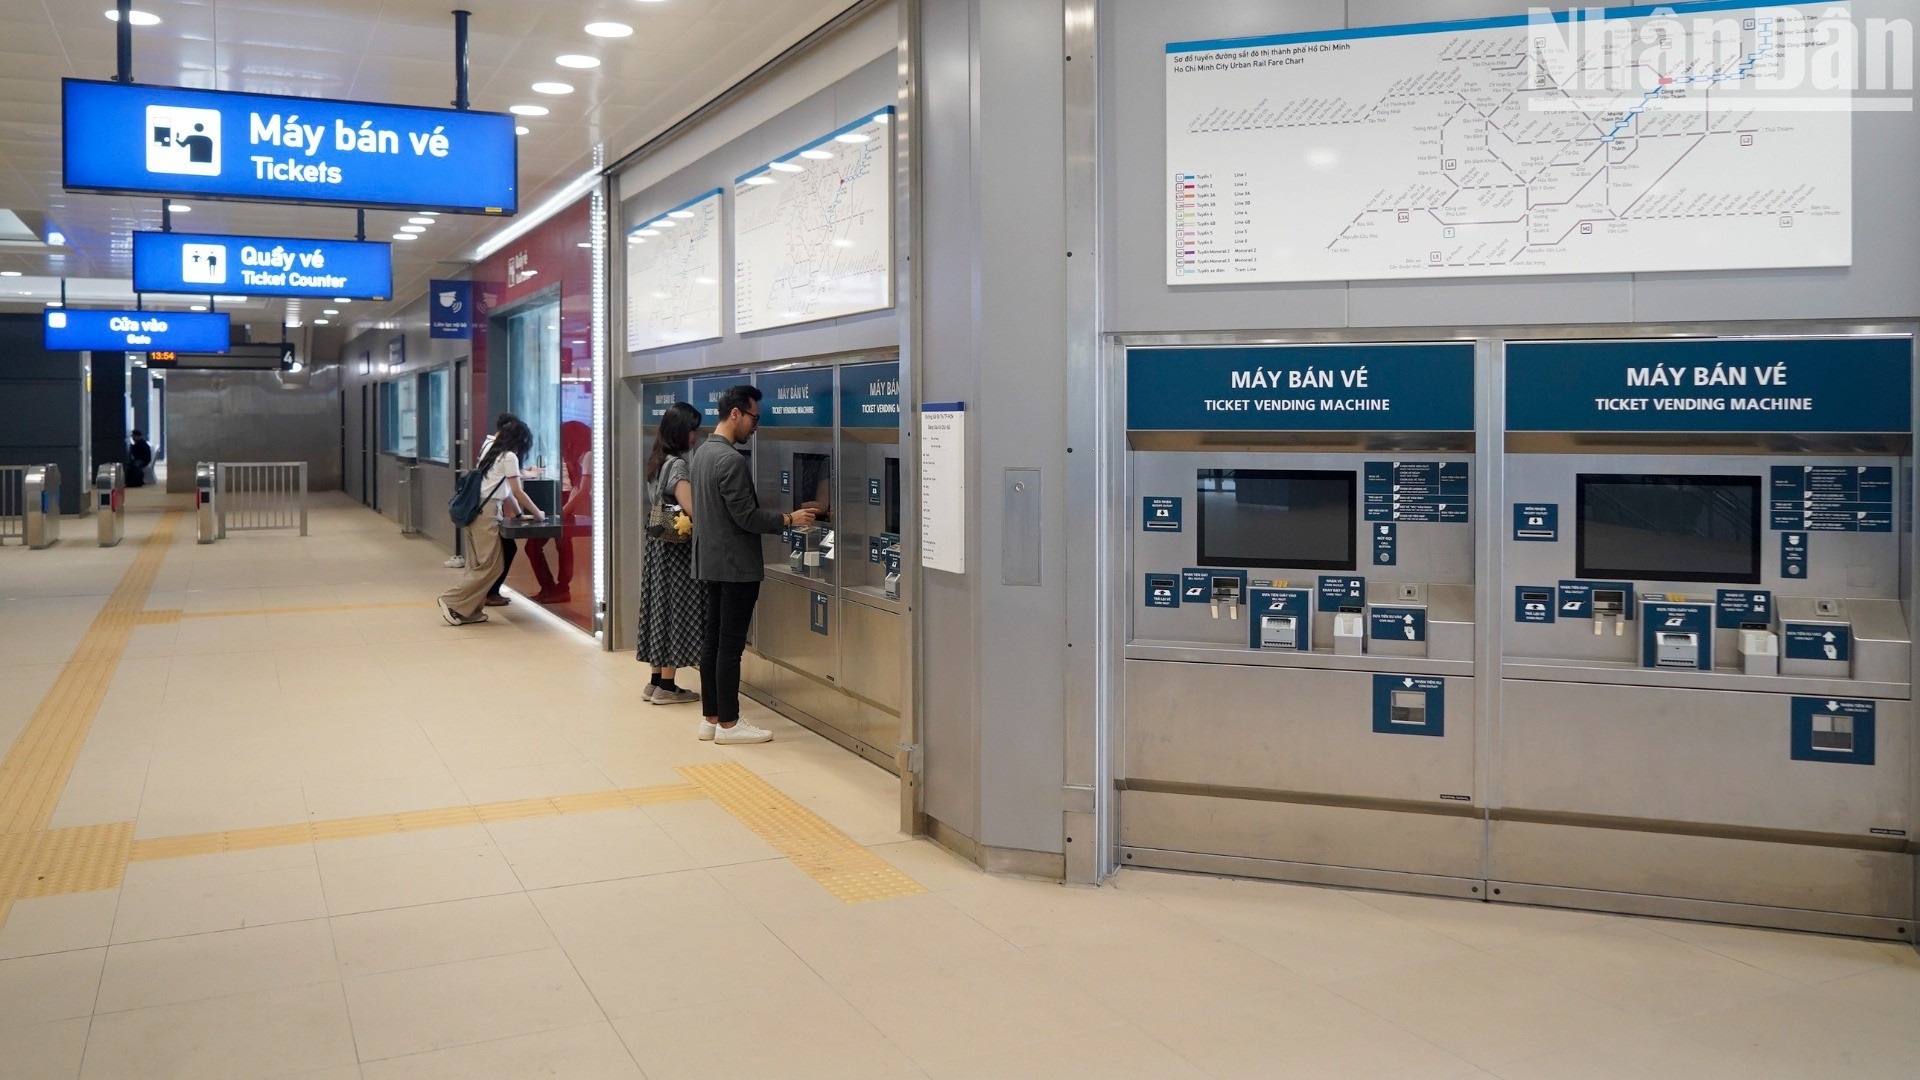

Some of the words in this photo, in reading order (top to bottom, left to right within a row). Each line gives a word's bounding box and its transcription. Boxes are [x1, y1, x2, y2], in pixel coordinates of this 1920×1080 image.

[1195, 51, 1213, 63] tuyến
[1215, 51, 1237, 62] đường
[1260, 48, 1270, 57] thị
[1271, 47, 1291, 56] thành
[1293, 45, 1306, 56] phố
[1333, 43, 1350, 51] Minh
[1216, 62, 1229, 72] City
[1230, 61, 1251, 69] Urban
[1285, 57, 1304, 65] Chart
[250, 112, 325, 156] Máy
[335, 118, 399, 154] bán
[408, 125, 449, 157] vé
[250, 155, 342, 184] Tickets
[299, 249, 325, 268] vé
[241, 270, 286, 286] Ticket
[288, 271, 348, 288] Counter
[110, 316, 140, 332] Cửa
[141, 318, 168, 332] vào
[151, 351, 175, 360] 13:54
[283, 351, 293, 363] 4
[1231, 366, 1282, 388] MÁY
[1289, 366, 1333, 388] BÁN
[1340, 365, 1368, 388] VÉ
[1626, 362, 1686, 386] MÁY
[1694, 362, 1747, 386] BÁN
[1754, 361, 1787, 385] VÉ
[777, 385, 789, 399] MÁY
[790, 384, 801, 399] BÁN
[801, 384, 809, 399] VÉ
[869, 379, 886, 396] MÁY
[772, 406, 782, 414] TICKET
[783, 406, 797, 414] VENDING
[797, 406, 814, 414] MACHINE
[862, 404, 876, 413] TICKET
[877, 404, 895, 413] VENDING
[1204, 399, 1250, 411] TICKET
[1254, 399, 1316, 411] VENDING
[1320, 399, 1390, 411] MACHINE
[1595, 398, 1649, 410] TICKET
[1653, 398, 1725, 410] VENDING
[1730, 398, 1813, 410] MACHINE
